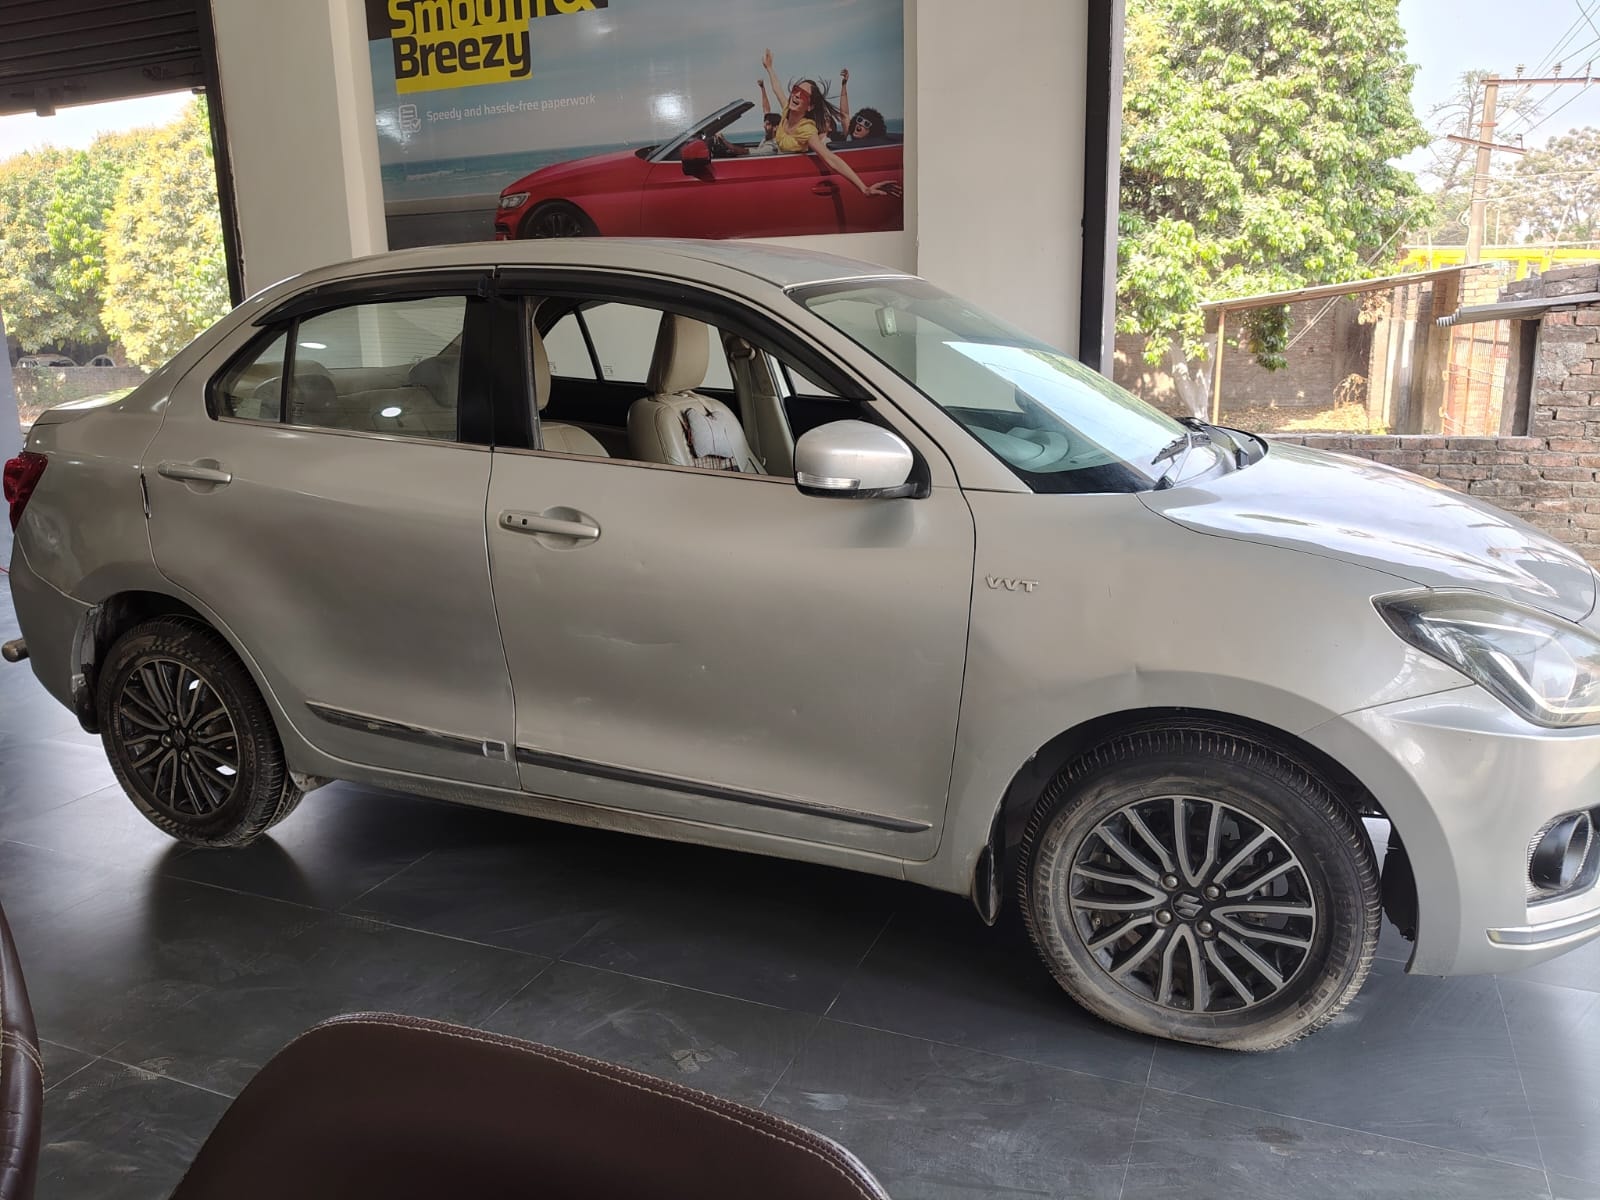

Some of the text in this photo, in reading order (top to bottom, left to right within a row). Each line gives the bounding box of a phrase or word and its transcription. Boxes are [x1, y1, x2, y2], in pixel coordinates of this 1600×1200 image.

[392, 31, 531, 79] Breezy
[426, 93, 596, 123] Speedy and hassle-free paperwork
[984, 574, 1039, 592] VVT
